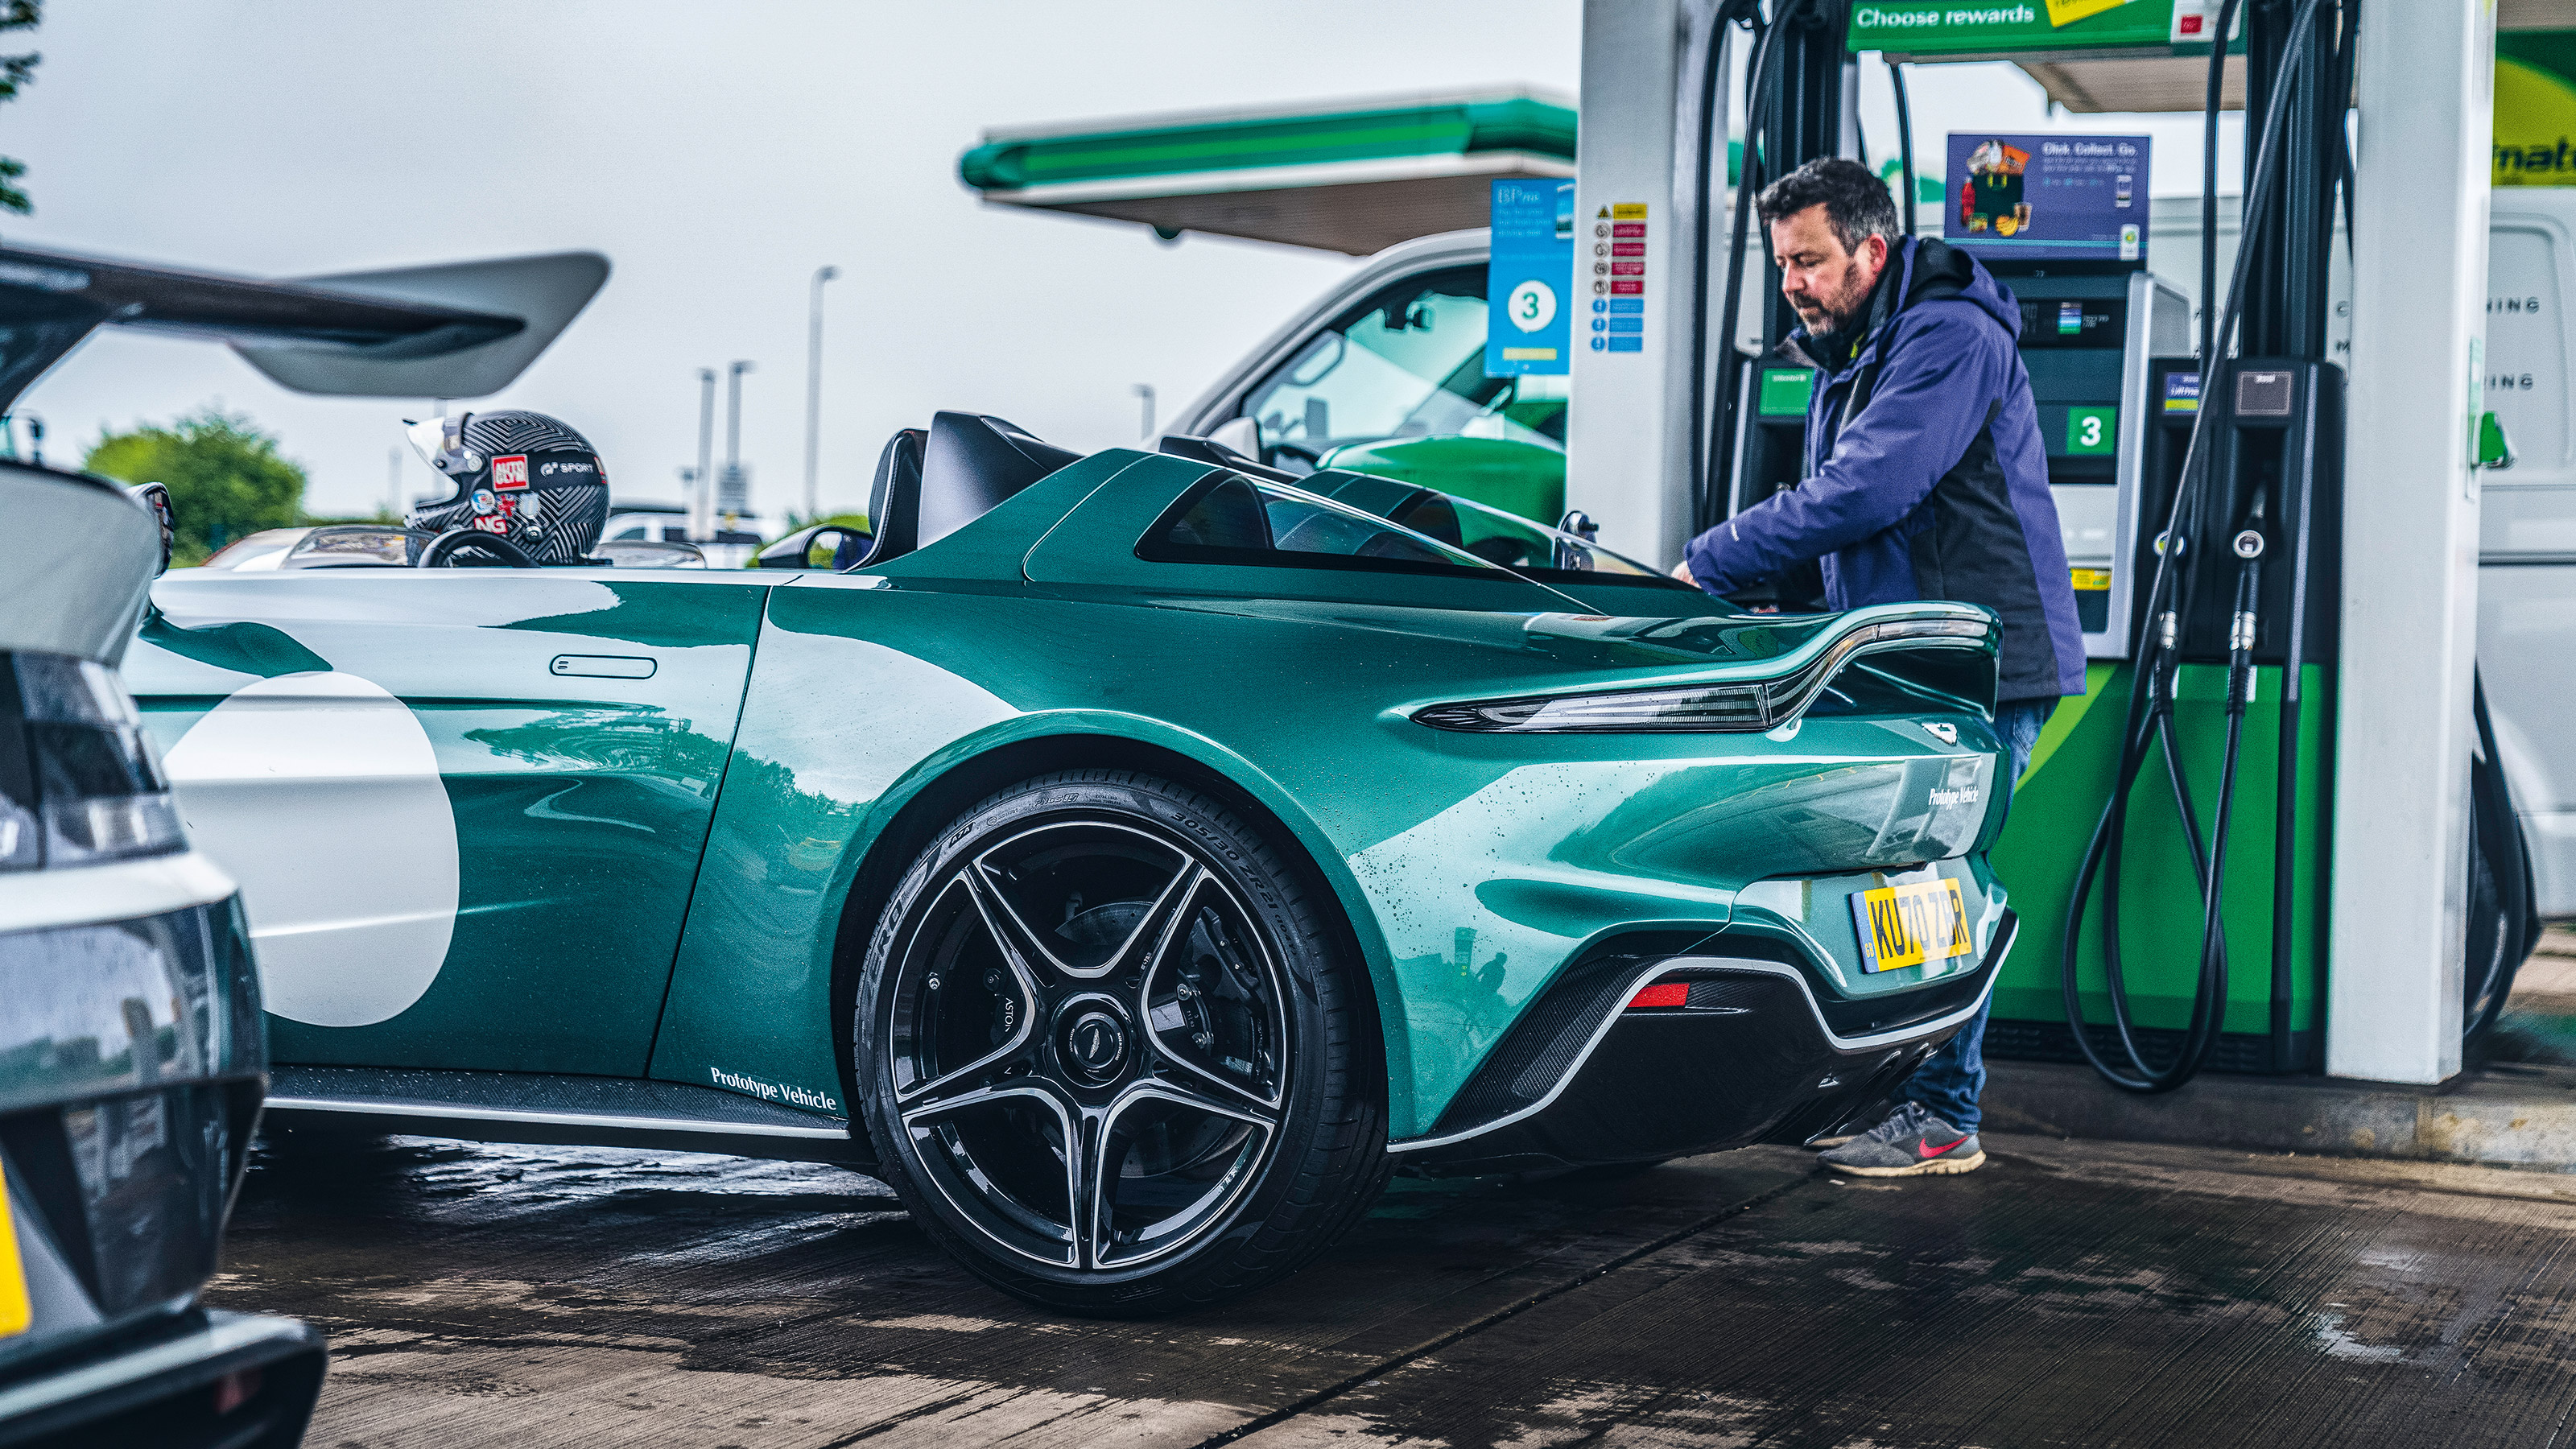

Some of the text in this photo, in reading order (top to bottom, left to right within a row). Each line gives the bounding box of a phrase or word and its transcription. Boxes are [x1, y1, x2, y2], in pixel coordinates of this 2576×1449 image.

[1857, 2, 2035, 28] Choose rewards
[1521, 291, 1538, 320] 3
[2080, 415, 2102, 447] 3
[559, 462, 593, 473] SPORT
[475, 516, 506, 532] NG
[1928, 785, 1979, 811] Prototype Vehicle
[1171, 812, 1240, 861] 305/30
[1870, 894, 1931, 960] KU70
[1864, 942, 1875, 958] GB
[710, 1067, 837, 1110] Prototype Vehicle
